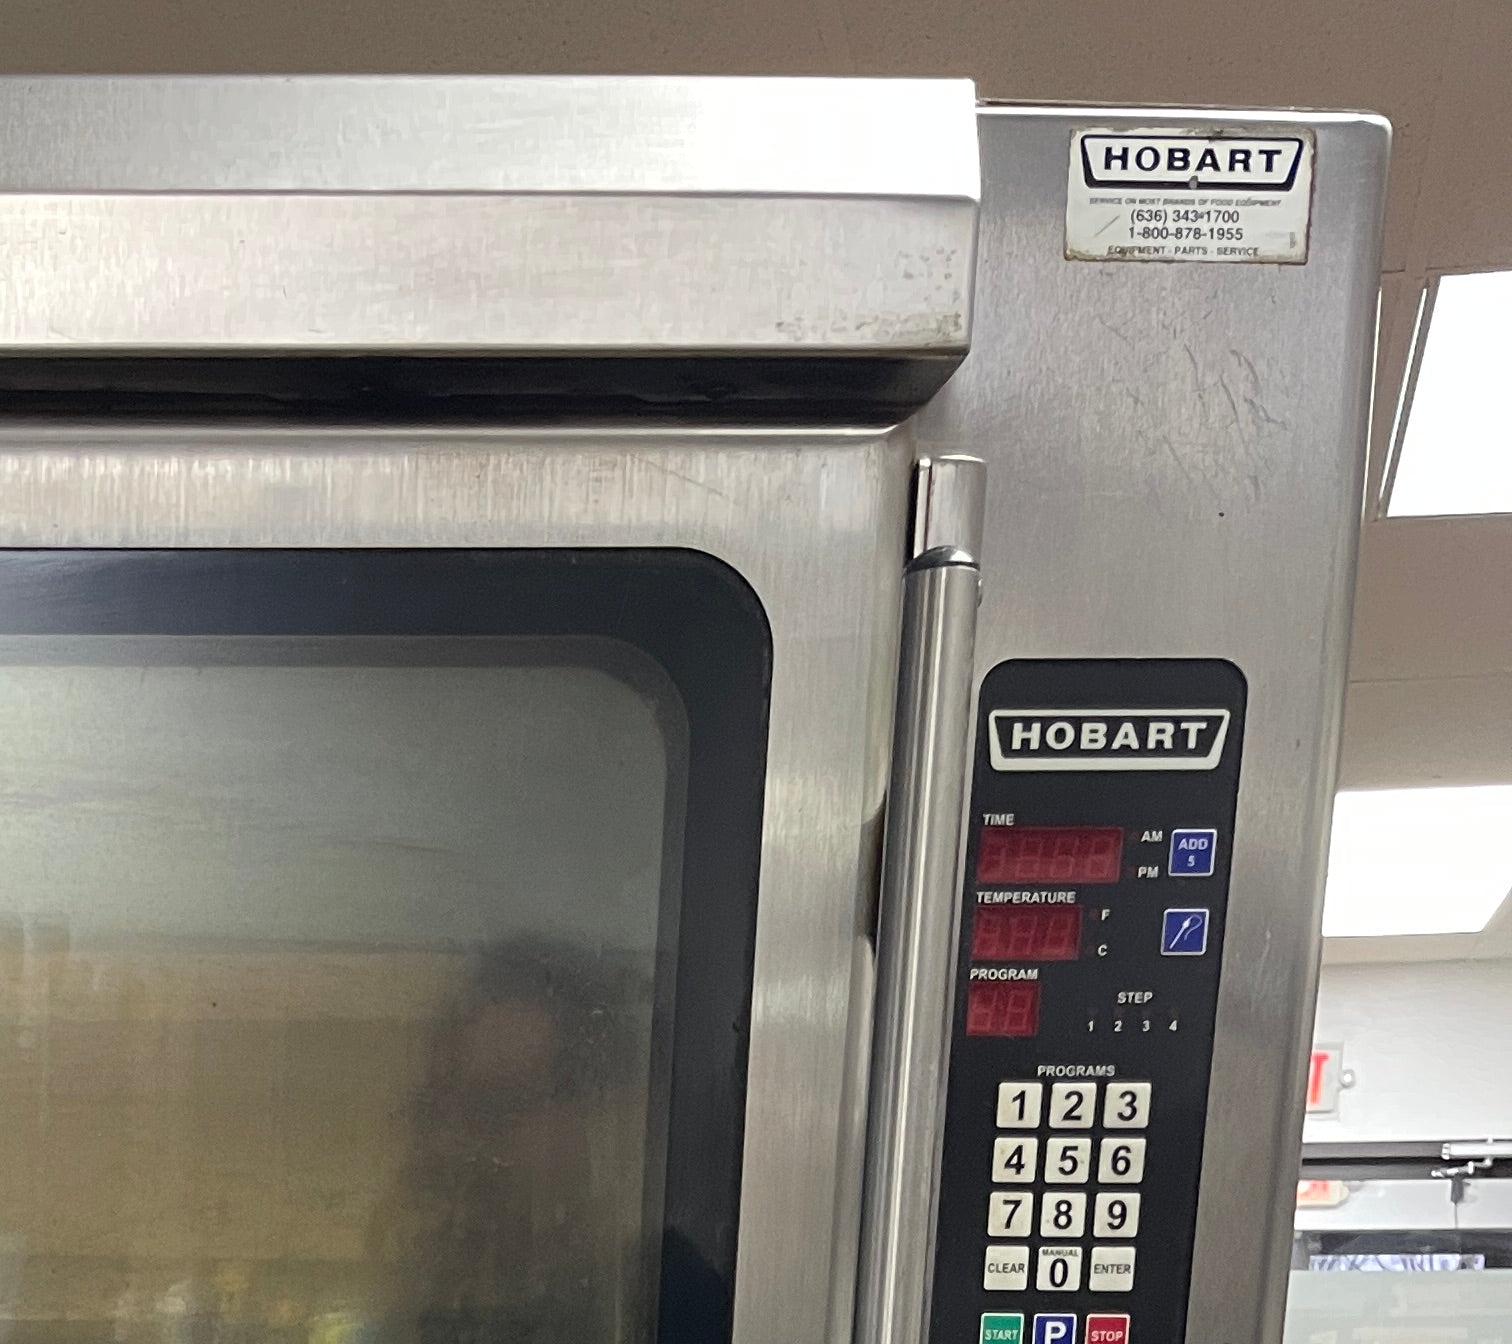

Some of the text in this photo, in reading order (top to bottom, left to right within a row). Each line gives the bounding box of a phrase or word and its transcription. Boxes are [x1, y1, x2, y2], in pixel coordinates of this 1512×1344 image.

[1104, 146, 1283, 172] HOBART
[1130, 209, 1240, 223] (636) 343-1700
[1128, 226, 1244, 240] 1-800-878-1955
[1174, 246, 1208, 256] PARTS
[1216, 246, 1259, 257] SERVICE
[1011, 722, 1208, 751] HOBART
[982, 813, 1015, 826] TIME
[1141, 830, 1163, 843] AM
[1178, 838, 1208, 851] ADD
[1137, 866, 1159, 879] PM
[976, 891, 1076, 904] TEMPERATURE
[1101, 909, 1110, 921] F
[1098, 944, 1108, 956] C
[970, 968, 1038, 981] PROGRAM
[1117, 992, 1153, 1004] STEP
[1088, 1020, 1178, 1032] 1 2 3 4
[1037, 1064, 1116, 1077] PROGRAMS
[1011, 1090, 1138, 1122] 1 2 3
[1004, 1145, 1131, 1176] 4 5 6
[1002, 1199, 1128, 1230] 7 8 9
[988, 1262, 1025, 1275] CLEAR
[1049, 1258, 1069, 1288] 0
[1093, 1263, 1131, 1275] ENTER
[984, 1329, 1018, 1341] START
[1090, 1330, 1124, 1342] STOP
